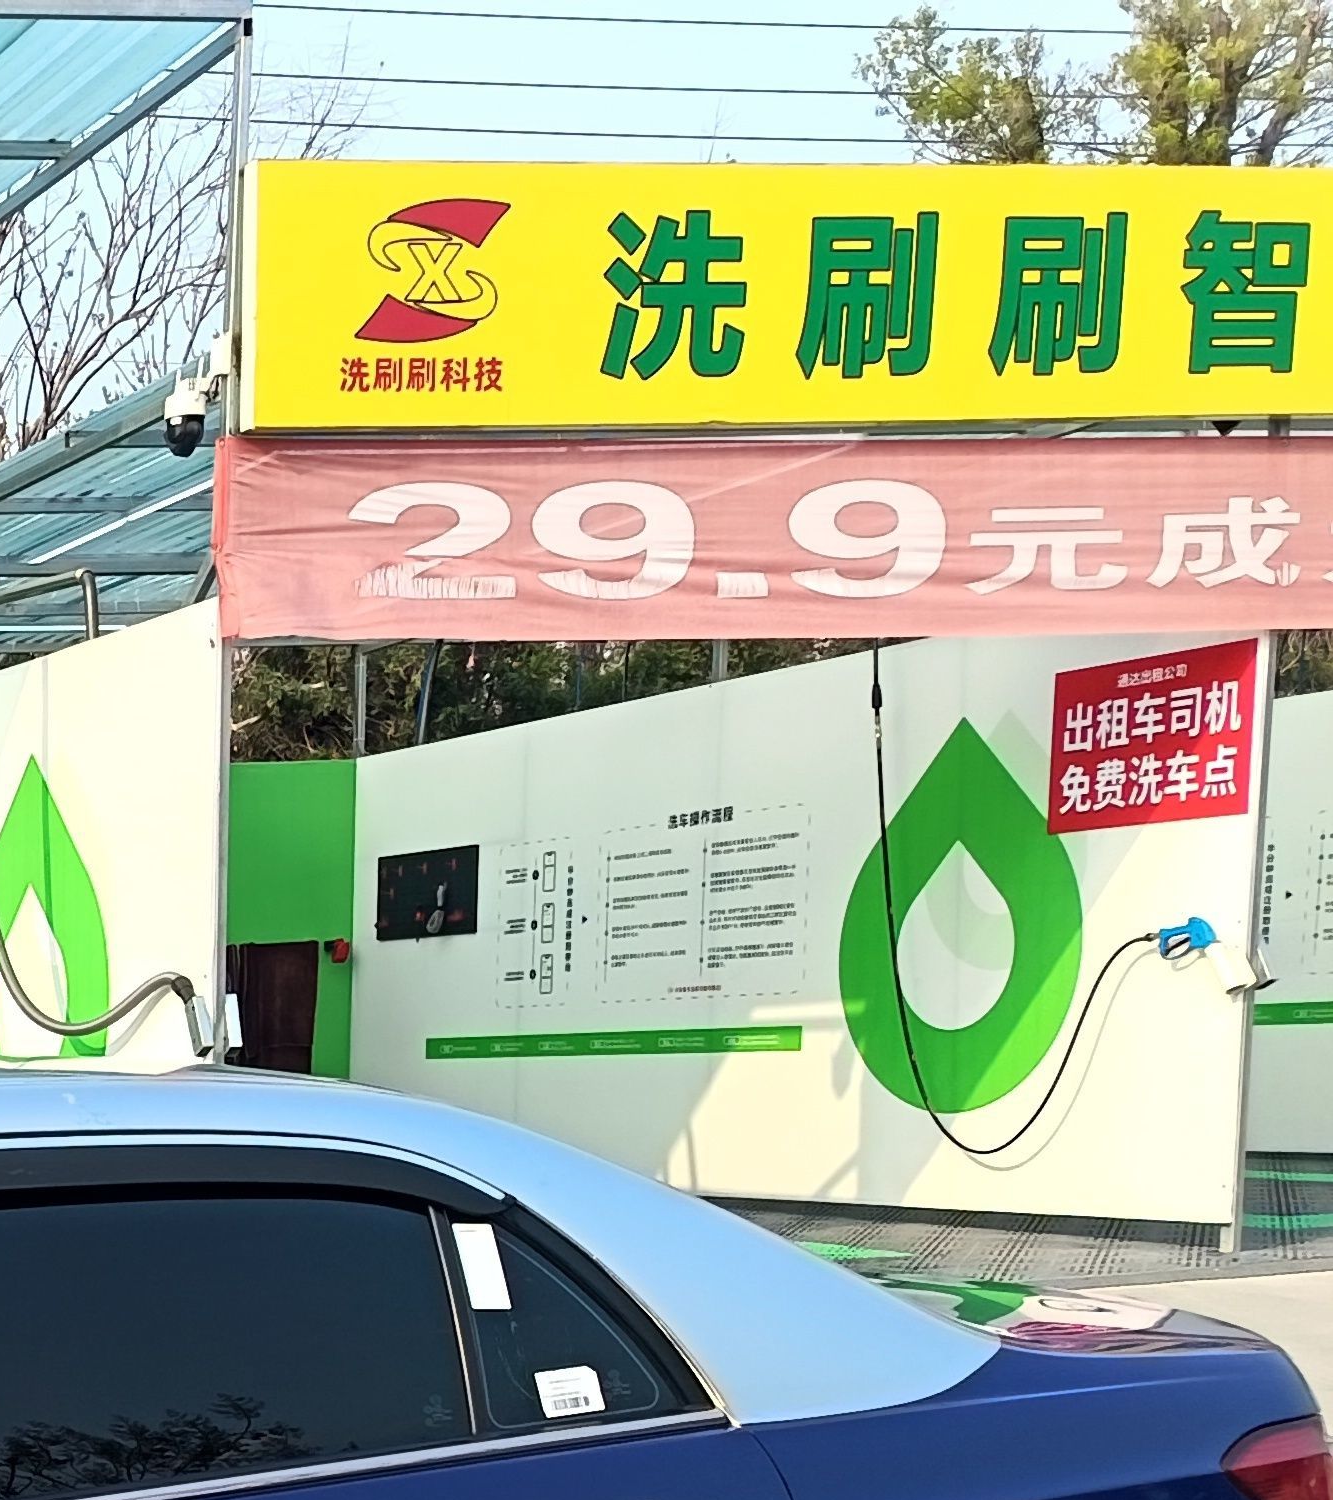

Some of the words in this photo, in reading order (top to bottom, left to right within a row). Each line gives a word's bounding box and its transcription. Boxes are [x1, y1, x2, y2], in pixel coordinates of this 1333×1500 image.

[599, 209, 1312, 382] 洗刷刷智
[340, 357, 503, 392] 洗刷刷科技
[348, 479, 1333, 600] 29.9元成
[1117, 664, 1188, 688] 通达出租公司
[1063, 681, 1242, 753] 出租车司机
[1059, 744, 1238, 815] 免费洗车点
